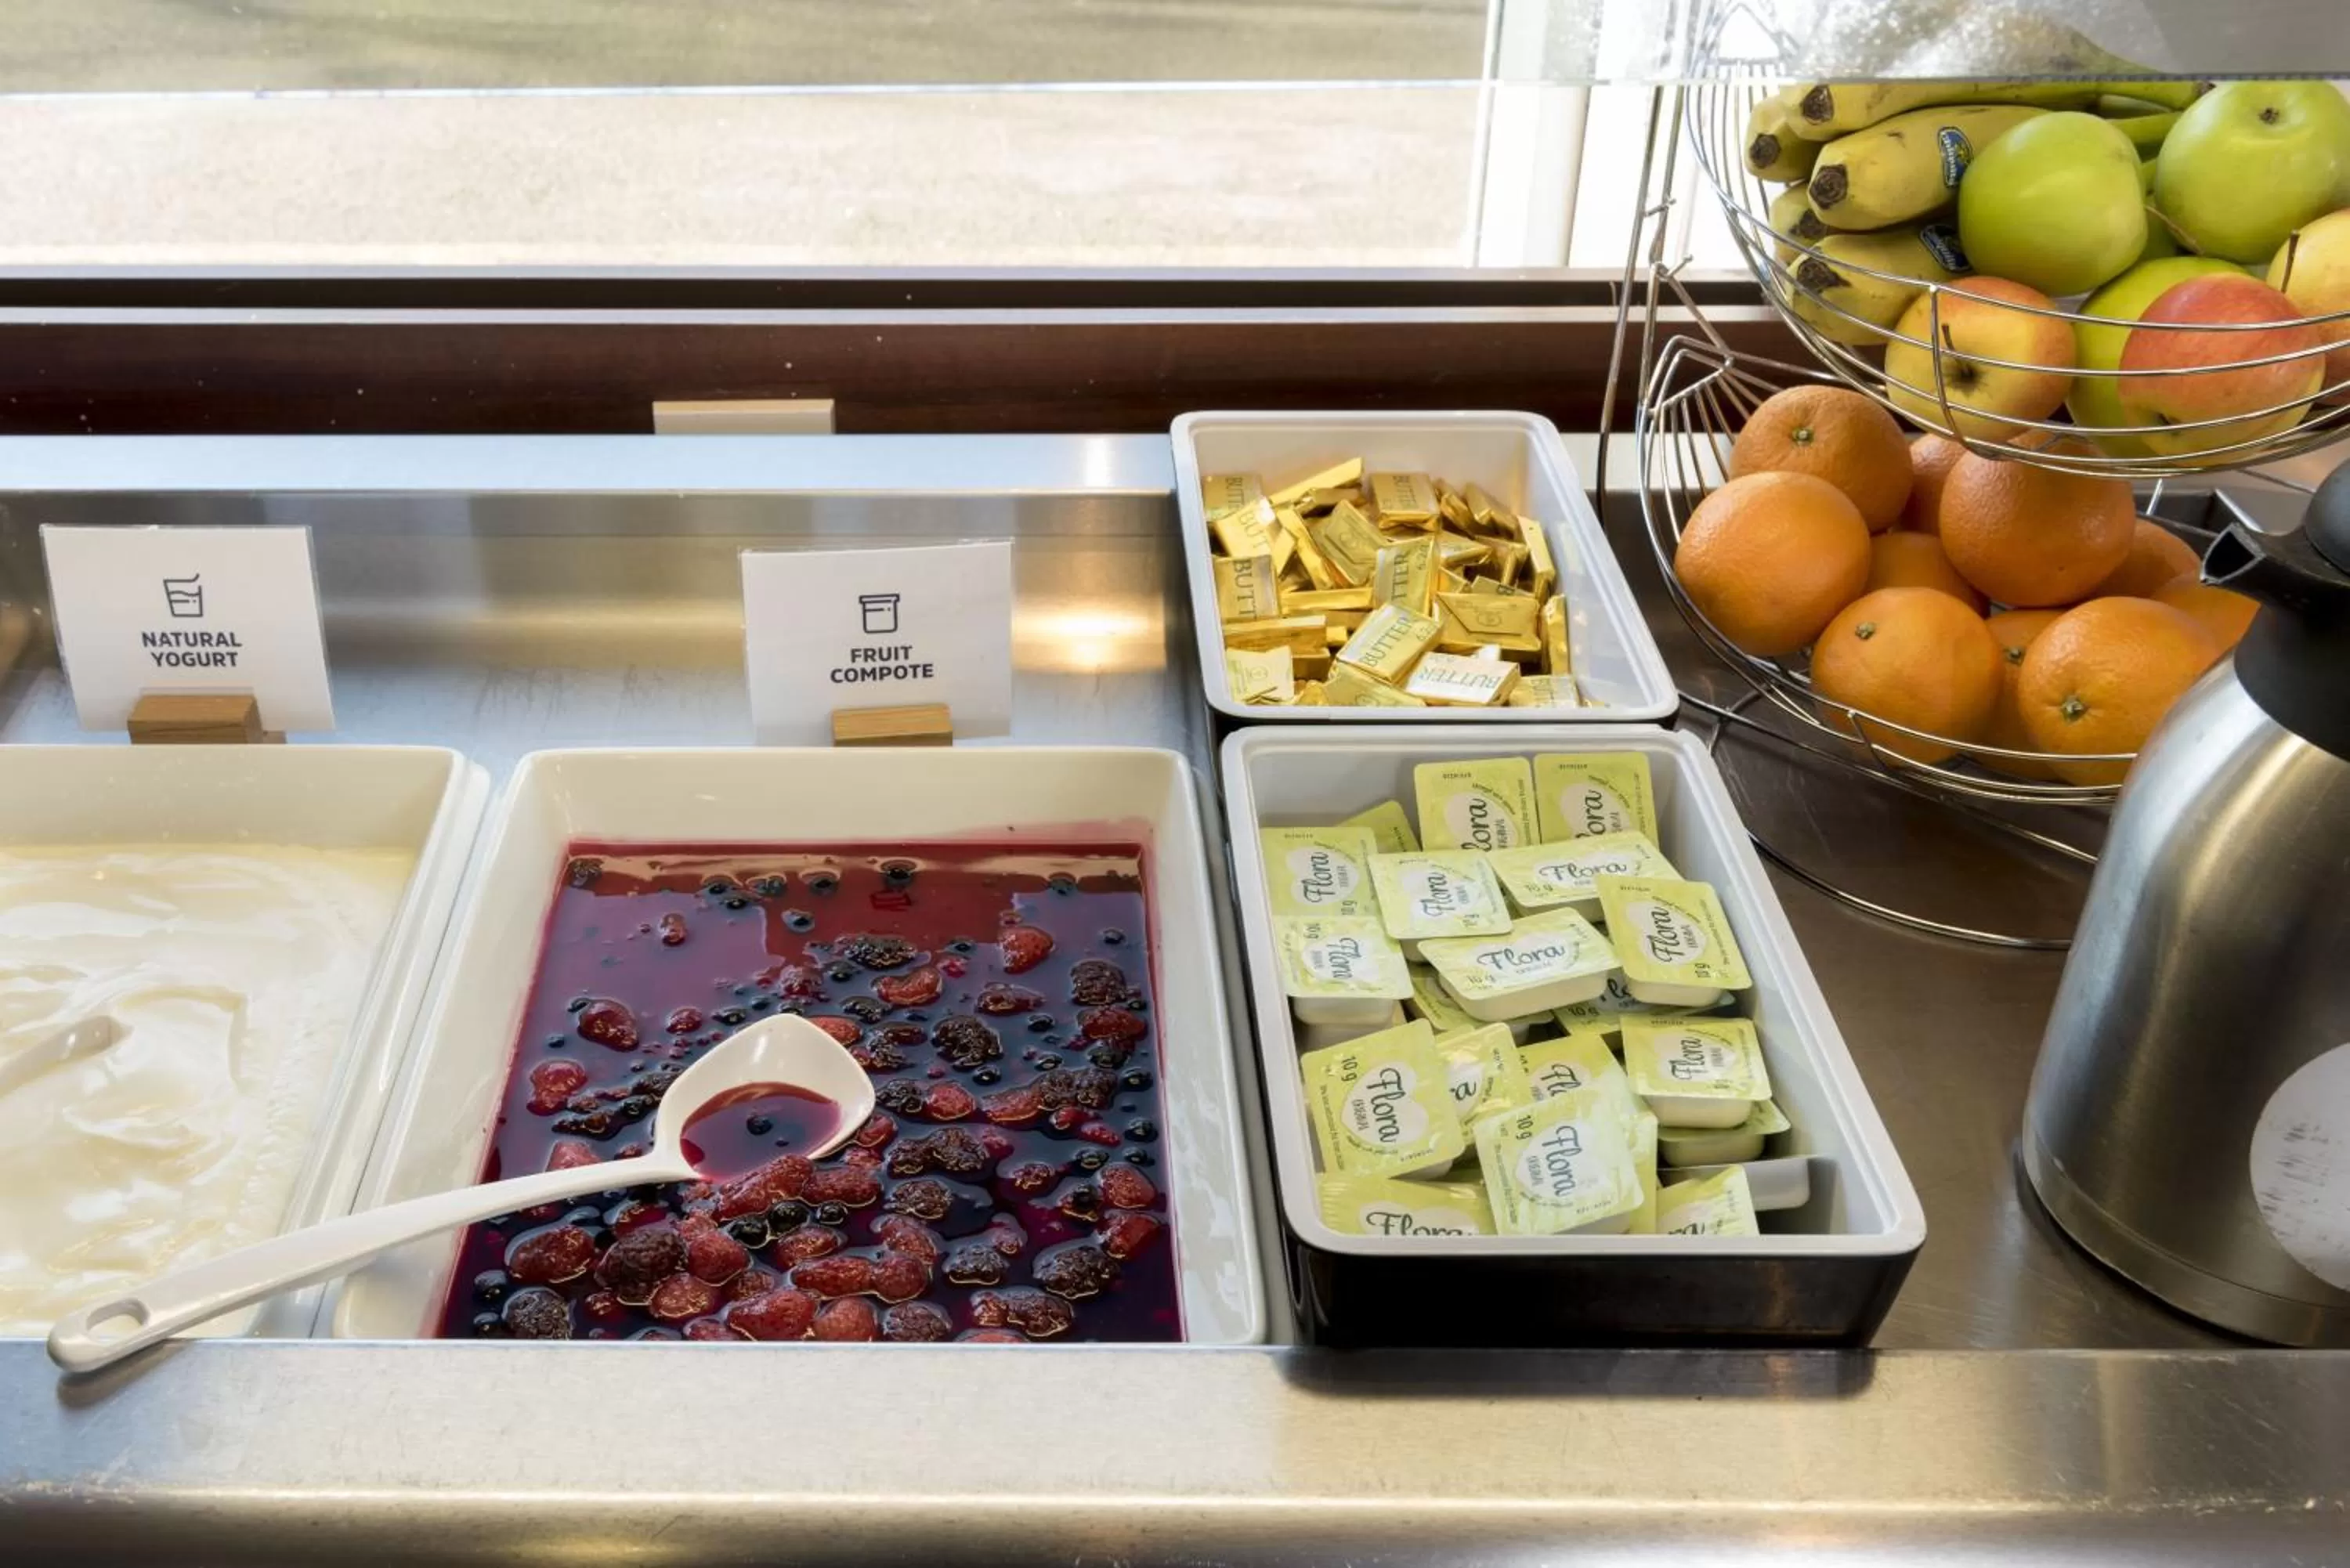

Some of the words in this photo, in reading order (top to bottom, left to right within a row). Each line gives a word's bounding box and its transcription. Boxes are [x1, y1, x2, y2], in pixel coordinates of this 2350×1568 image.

[1233, 558, 1257, 620] BUTT
[1391, 550, 1410, 602] TTER
[142, 631, 243, 649] NATURAL
[151, 651, 239, 668] YOGURT
[850, 645, 913, 663] FRUIT
[1360, 616, 1412, 667] BUTTER
[830, 664, 935, 684] COMPOTE
[1418, 666, 1501, 688] BUTTER
[1461, 797, 1492, 851] lora
[1575, 789, 1606, 839] ora
[1301, 851, 1336, 903] Flora
[1419, 872, 1456, 916] Flora
[1538, 862, 1627, 881] Flora
[1477, 943, 1567, 970] Flora
[1647, 906, 1684, 963] Flora
[1668, 1037, 1708, 1080] Flora
[1366, 1068, 1407, 1143] Flora
[1542, 1125, 1583, 1198] Flora
